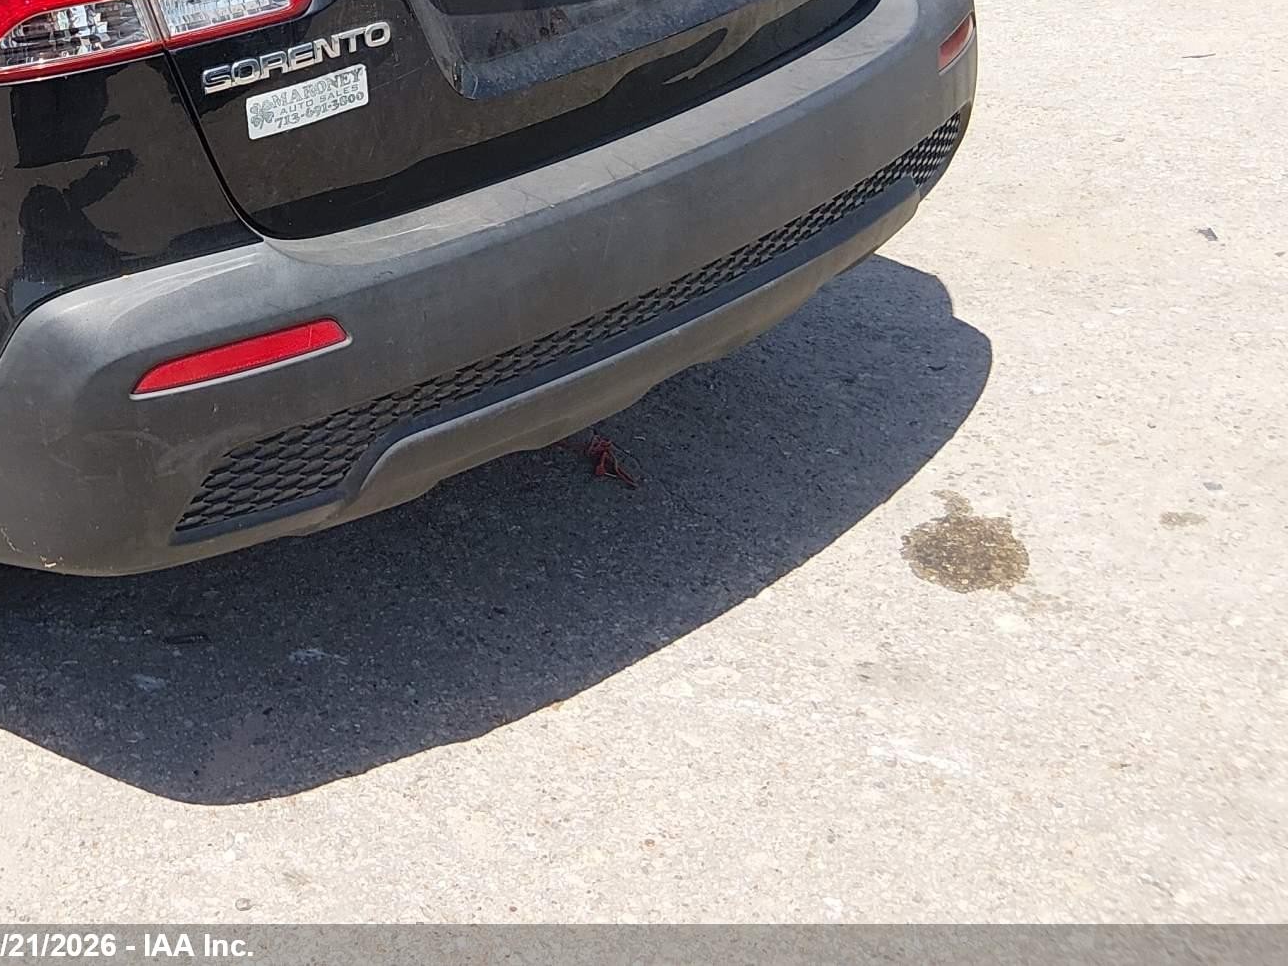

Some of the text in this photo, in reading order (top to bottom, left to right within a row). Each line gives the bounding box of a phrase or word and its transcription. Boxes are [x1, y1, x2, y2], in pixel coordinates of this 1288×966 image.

[202, 21, 391, 95] SORENTO
[280, 84, 359, 116] AUTO SALES
